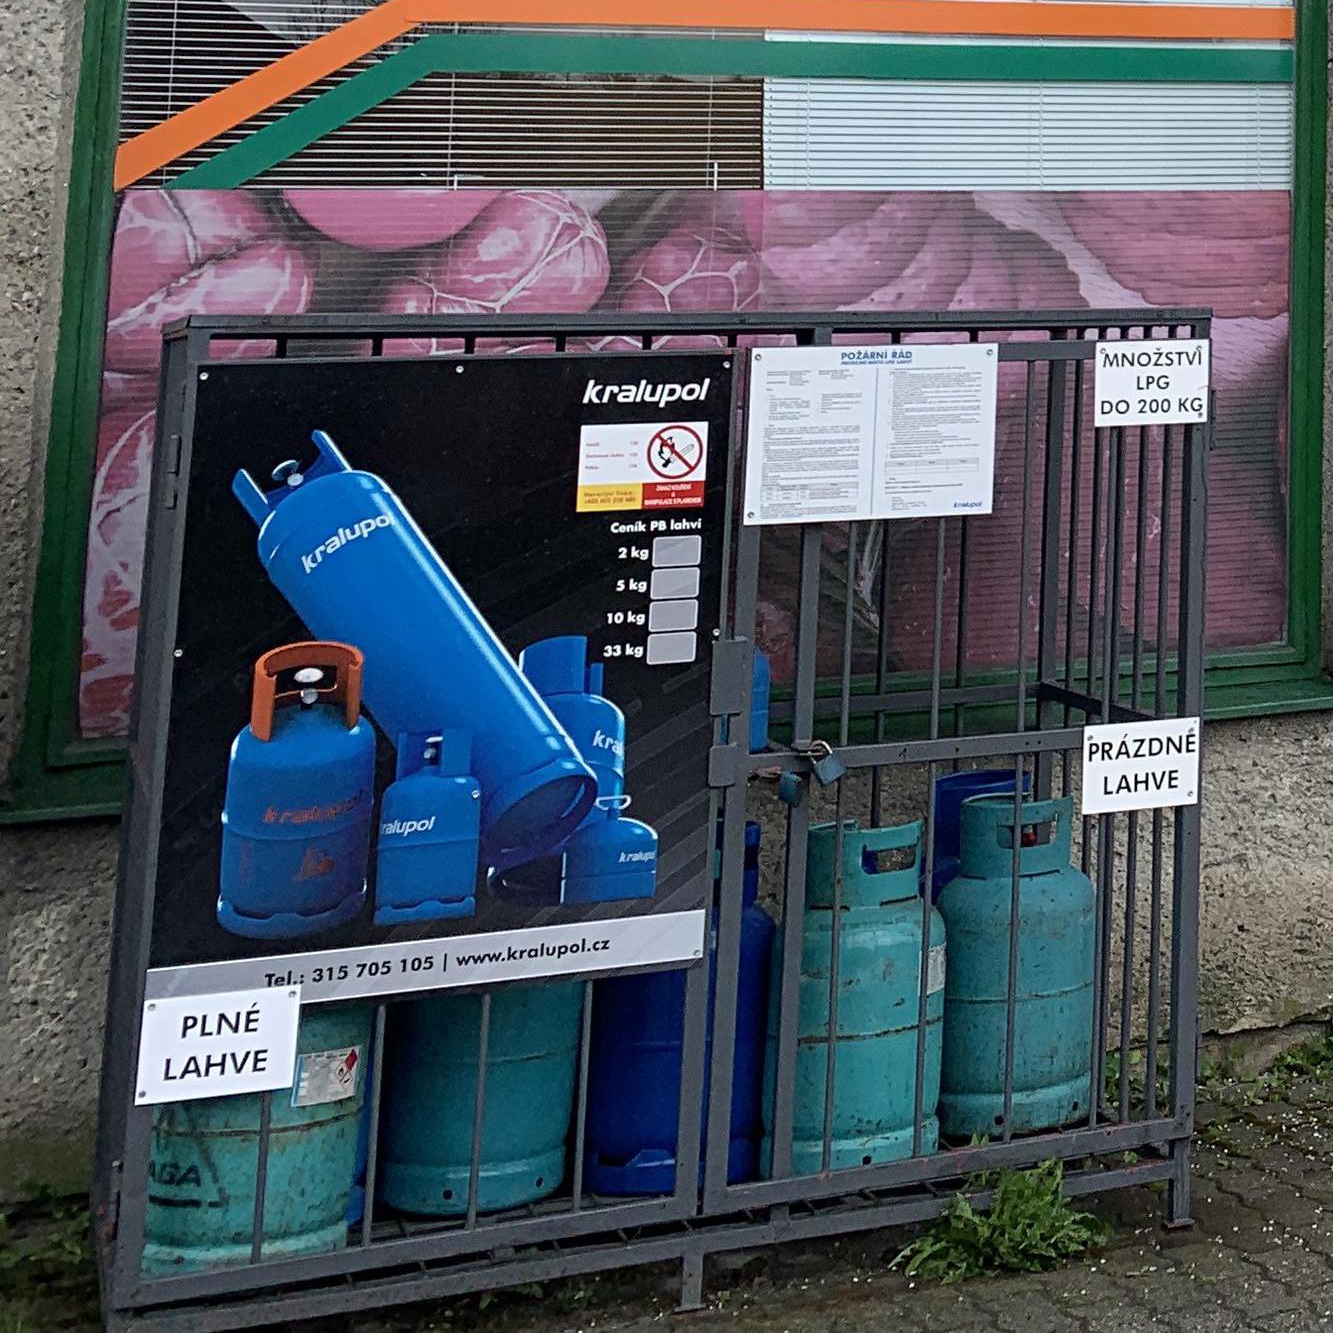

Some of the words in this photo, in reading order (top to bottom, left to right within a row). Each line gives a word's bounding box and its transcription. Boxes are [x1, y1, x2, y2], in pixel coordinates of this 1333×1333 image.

[840, 349, 888, 361] POŽÁRNÍ
[891, 349, 913, 359] ŘÁD
[1102, 344, 1202, 369] MNOŽSTVÍ
[1136, 374, 1171, 391] LPG
[582, 377, 711, 408] kralupol
[1100, 399, 1130, 416] DO
[1137, 398, 1171, 415] 200
[1177, 397, 1204, 413] KG
[609, 521, 647, 534] Ceník
[650, 520, 667, 532] PB
[618, 547, 628, 559] 2
[630, 546, 650, 561] kg
[616, 579, 626, 592] 5
[628, 578, 648, 593] kg
[607, 611, 625, 625] 10
[627, 610, 646, 625] kg
[603, 644, 622, 657] 33
[625, 643, 644, 658] kg
[1087, 731, 1197, 763] PRÁZDNÉ
[1102, 769, 1179, 795] LAHVE
[264, 971, 305, 988] Tel.:
[312, 964, 348, 984] 315
[356, 960, 392, 979] 705
[400, 955, 434, 974] 105
[456, 936, 611, 969] www.kralupol.cz
[180, 1003, 262, 1040] PLNÉ
[163, 1049, 269, 1082] LAHVE
